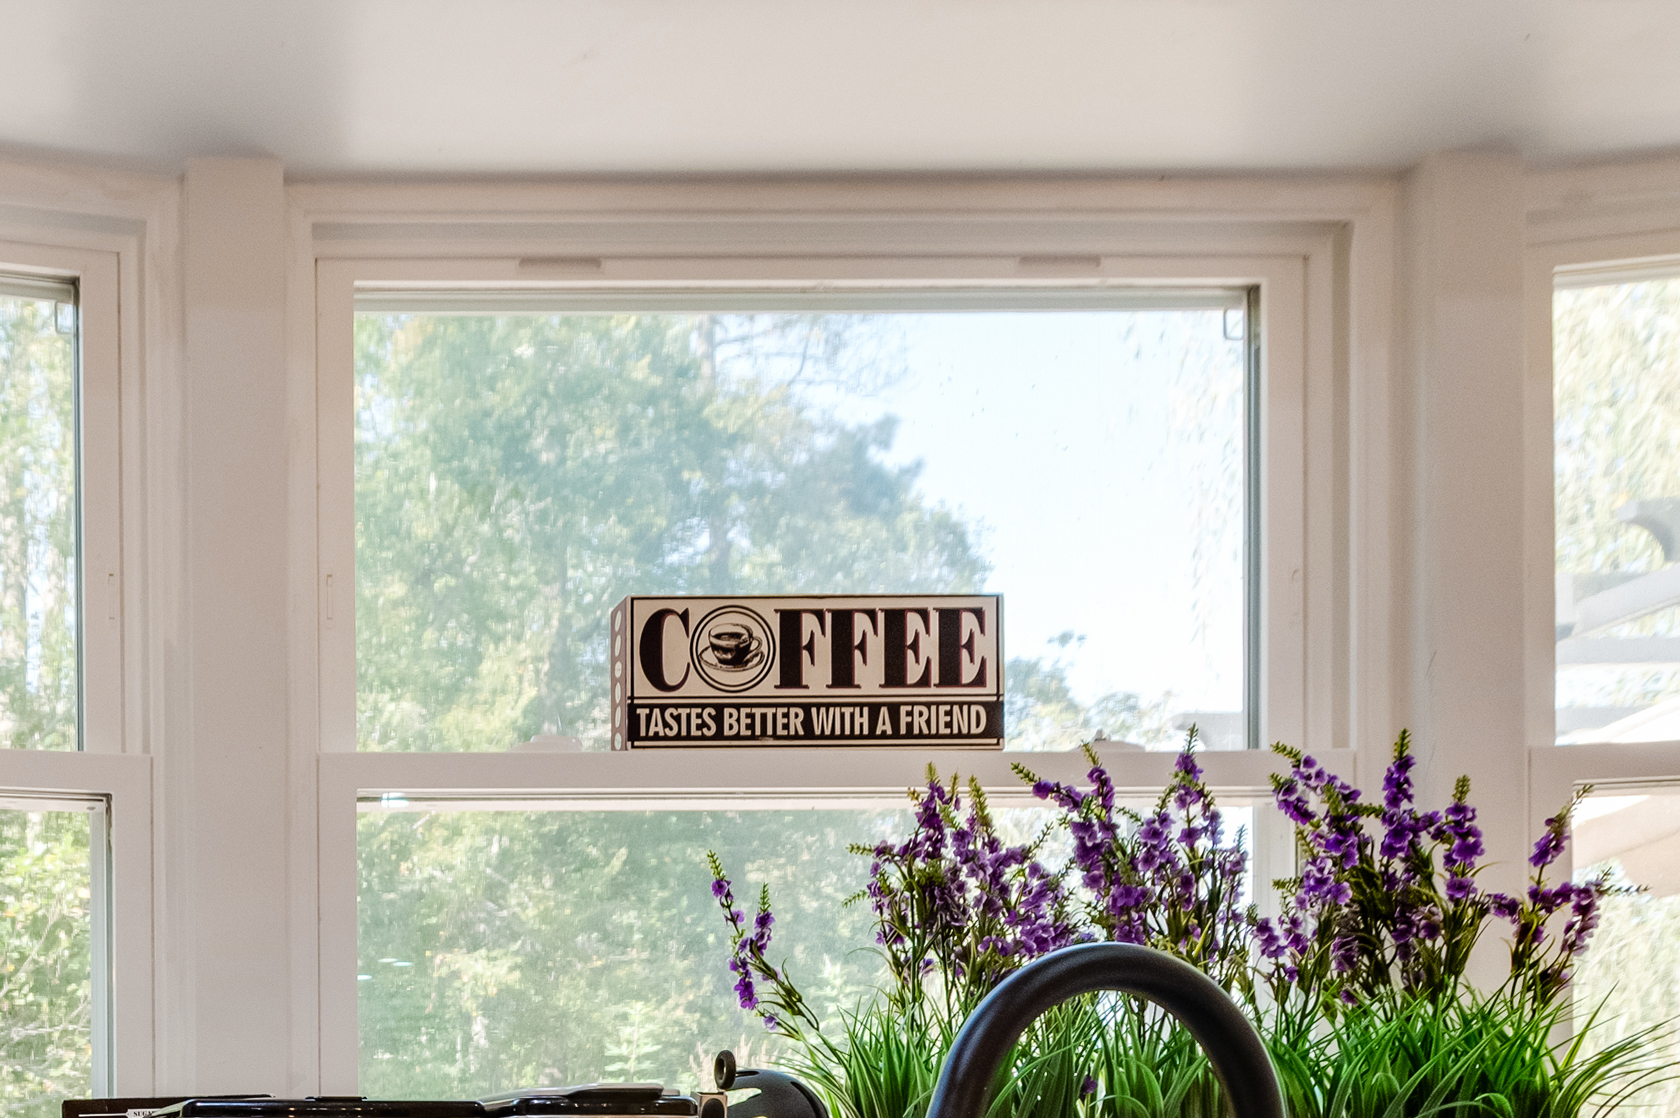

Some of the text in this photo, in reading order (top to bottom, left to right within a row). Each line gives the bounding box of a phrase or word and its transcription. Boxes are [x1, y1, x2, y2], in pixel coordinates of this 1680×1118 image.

[636, 704, 987, 737] TASTES BETTER WITH A FRIEND
